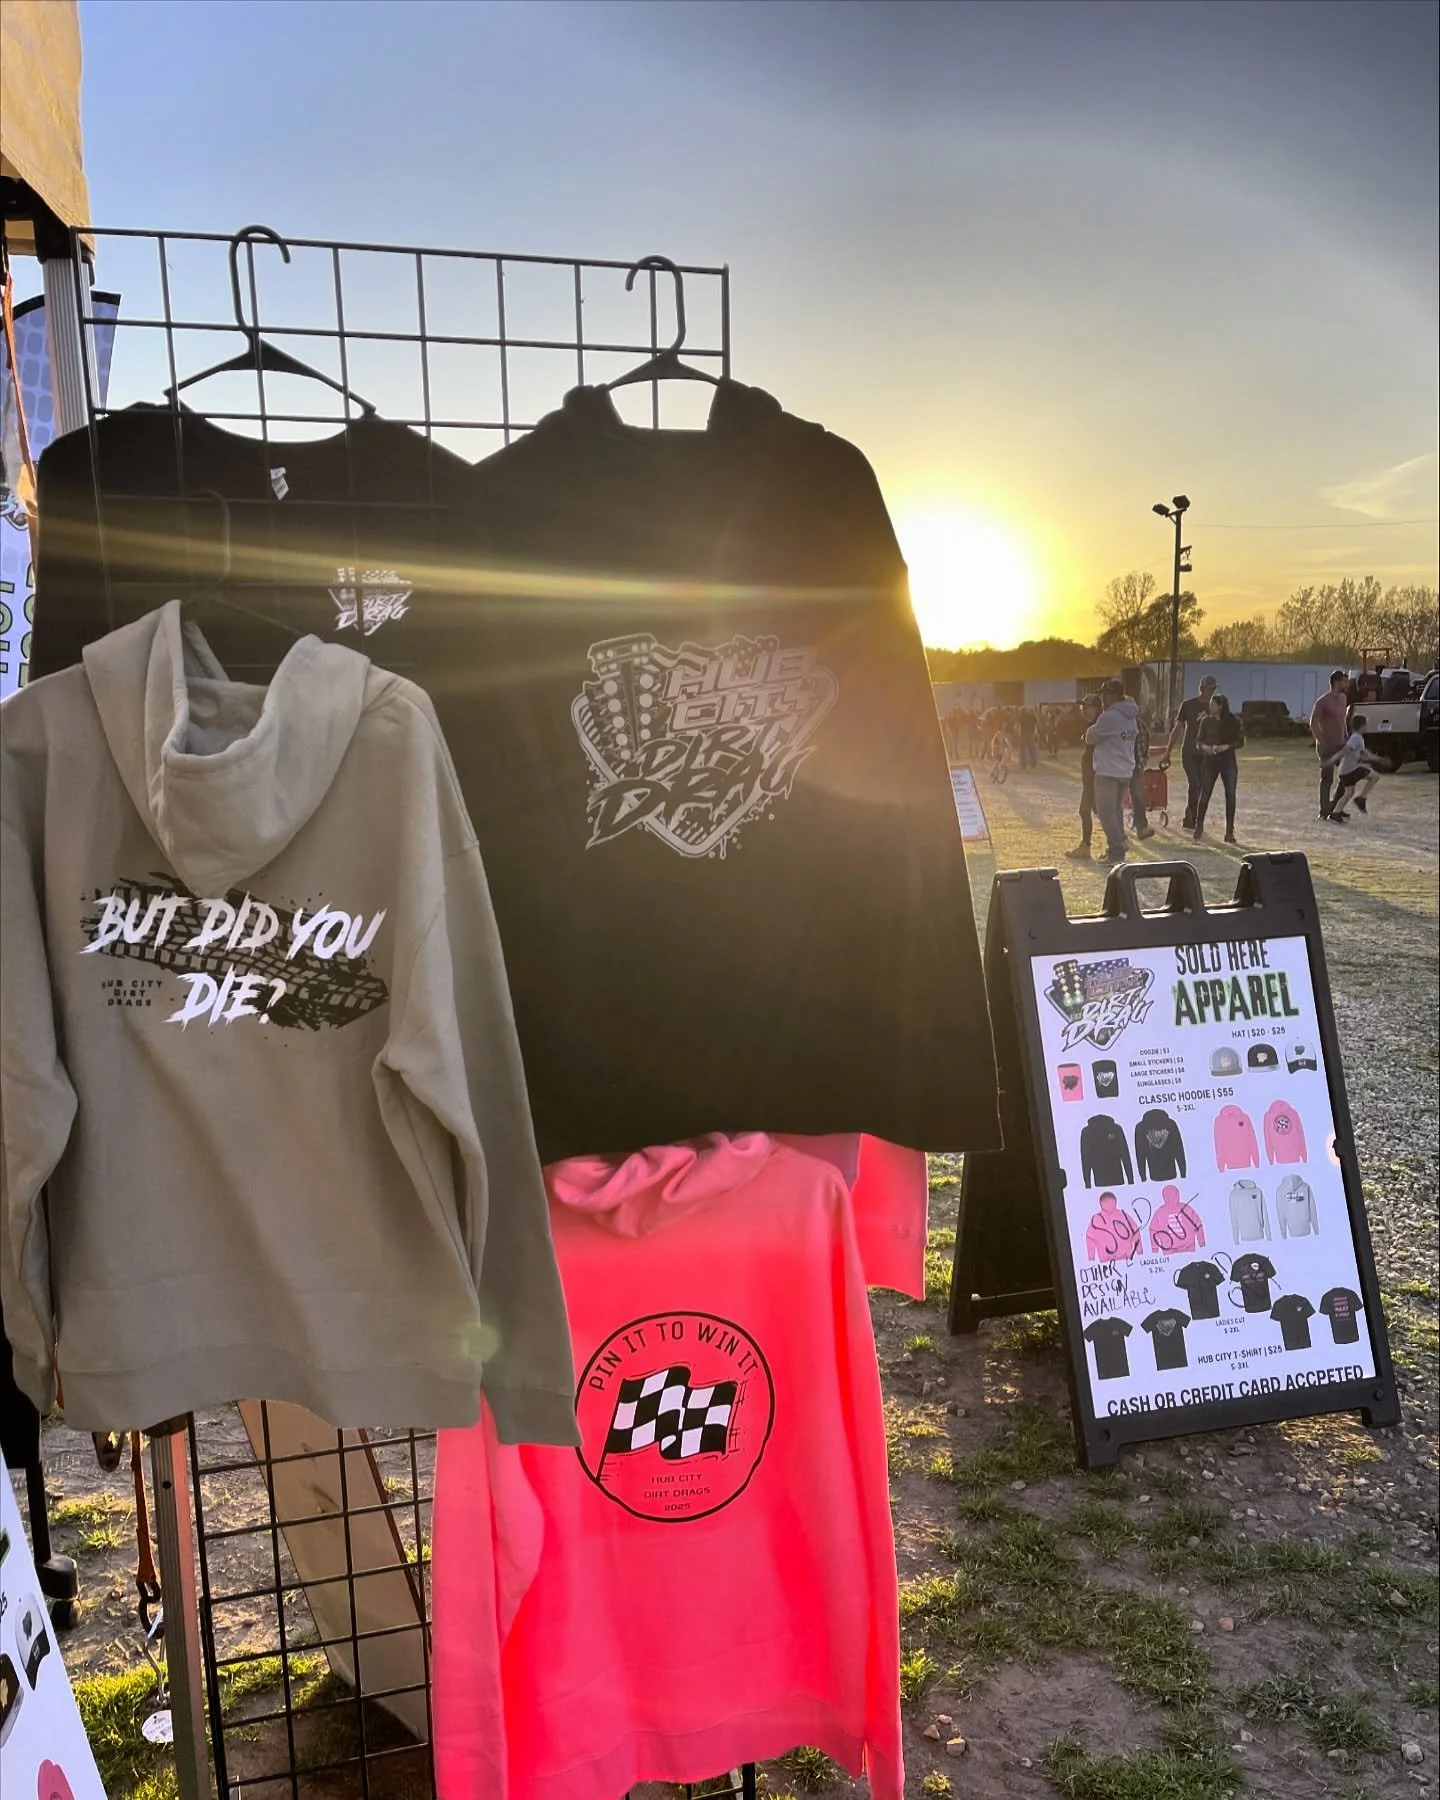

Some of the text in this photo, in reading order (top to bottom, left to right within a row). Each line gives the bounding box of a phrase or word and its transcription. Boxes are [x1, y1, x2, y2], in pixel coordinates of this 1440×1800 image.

[663, 647, 817, 700] HUB
[80, 888, 387, 960] BUT DID YOU
[1175, 939, 1271, 975] SOLD HERE
[114, 989, 146, 997] DIRT
[131, 980, 162, 988] CITY
[162, 963, 288, 1032] DIE?
[1173, 971, 1299, 1026] APPAREL
[1231, 1026, 1286, 1039] HAT $20 $25
[1137, 1078, 1172, 1087] SUNGLASSES
[1138, 1087, 1234, 1105] CLASSIC HOODIE $55
[1091, 1193, 1202, 1255] SOLD OUT
[1215, 1317, 1246, 1327] LADIES CUT
[588, 1321, 759, 1392] PIN IT TO WIN IT
[1197, 1345, 1283, 1365] HUB CITY T-SHIRT $25
[1107, 1364, 1363, 1416] CASH OR CREDIT CARD ACCPETED
[651, 1473, 703, 1484] HUB CITY
[643, 1486, 711, 1499] DIRT DRAGS
[664, 1502, 691, 1512] 2025
